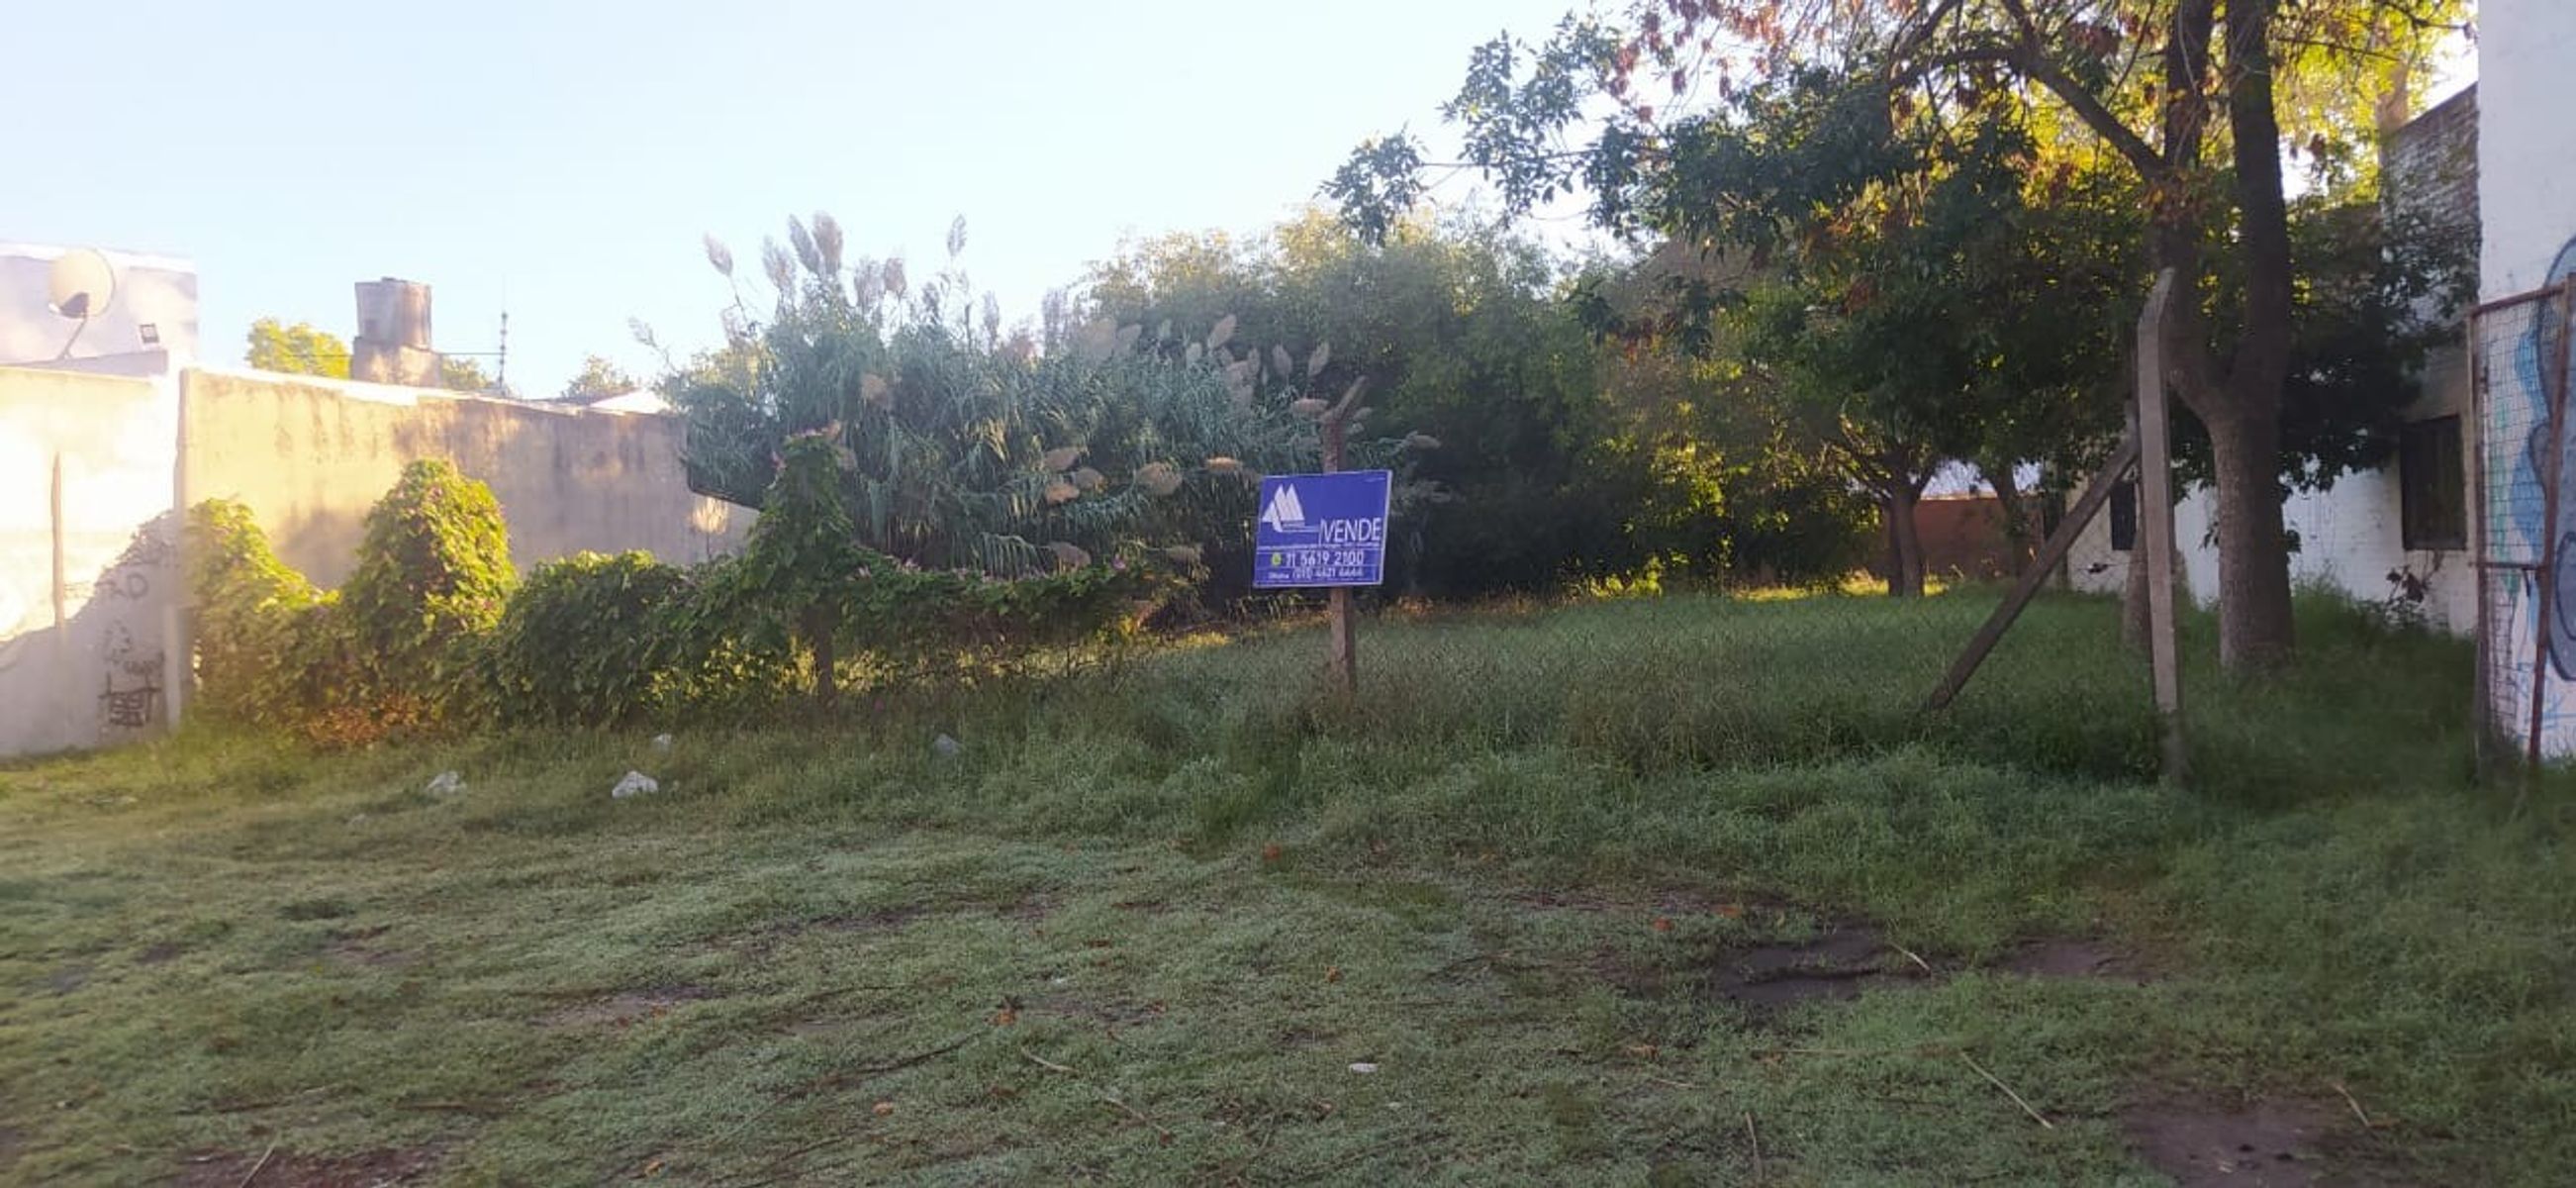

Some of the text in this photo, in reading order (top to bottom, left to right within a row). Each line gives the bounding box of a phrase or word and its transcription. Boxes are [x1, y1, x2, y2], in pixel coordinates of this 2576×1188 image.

[1321, 517, 1382, 544] VENDE
[1299, 550, 1329, 566] 5619
[1334, 549, 1364, 565] 2100
